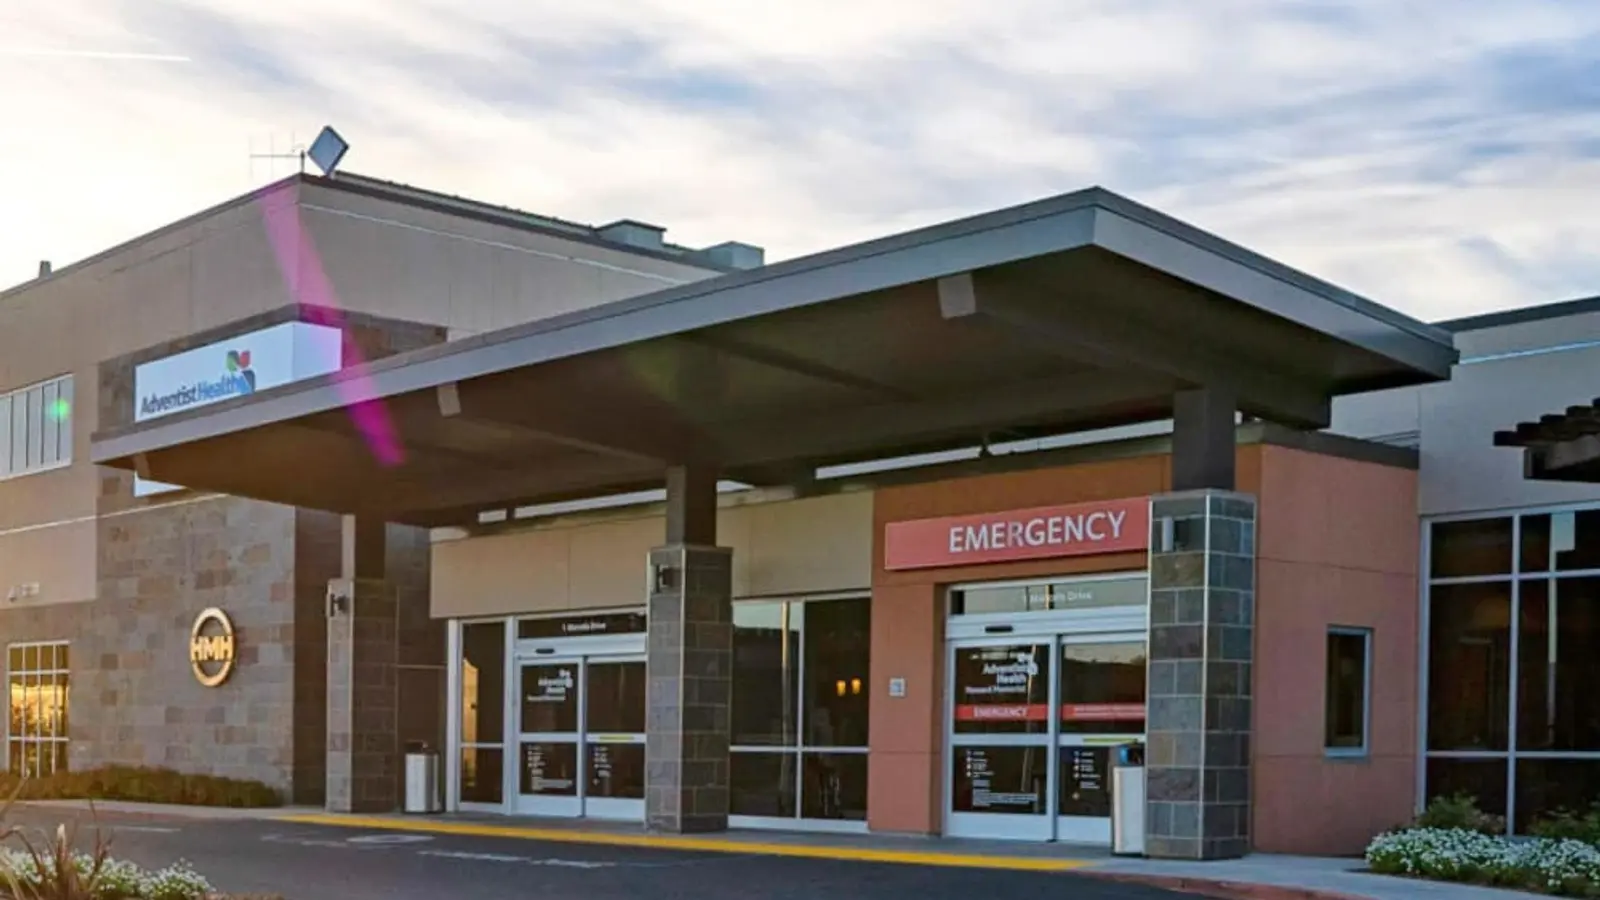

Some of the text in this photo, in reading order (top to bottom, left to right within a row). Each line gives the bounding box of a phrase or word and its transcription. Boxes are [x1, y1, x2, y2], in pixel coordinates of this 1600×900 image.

[140, 373, 237, 415] Adventist Health
[949, 510, 1127, 553] EMERGENCY
[1067, 590, 1092, 601] Drive
[190, 635, 234, 661] HMH
